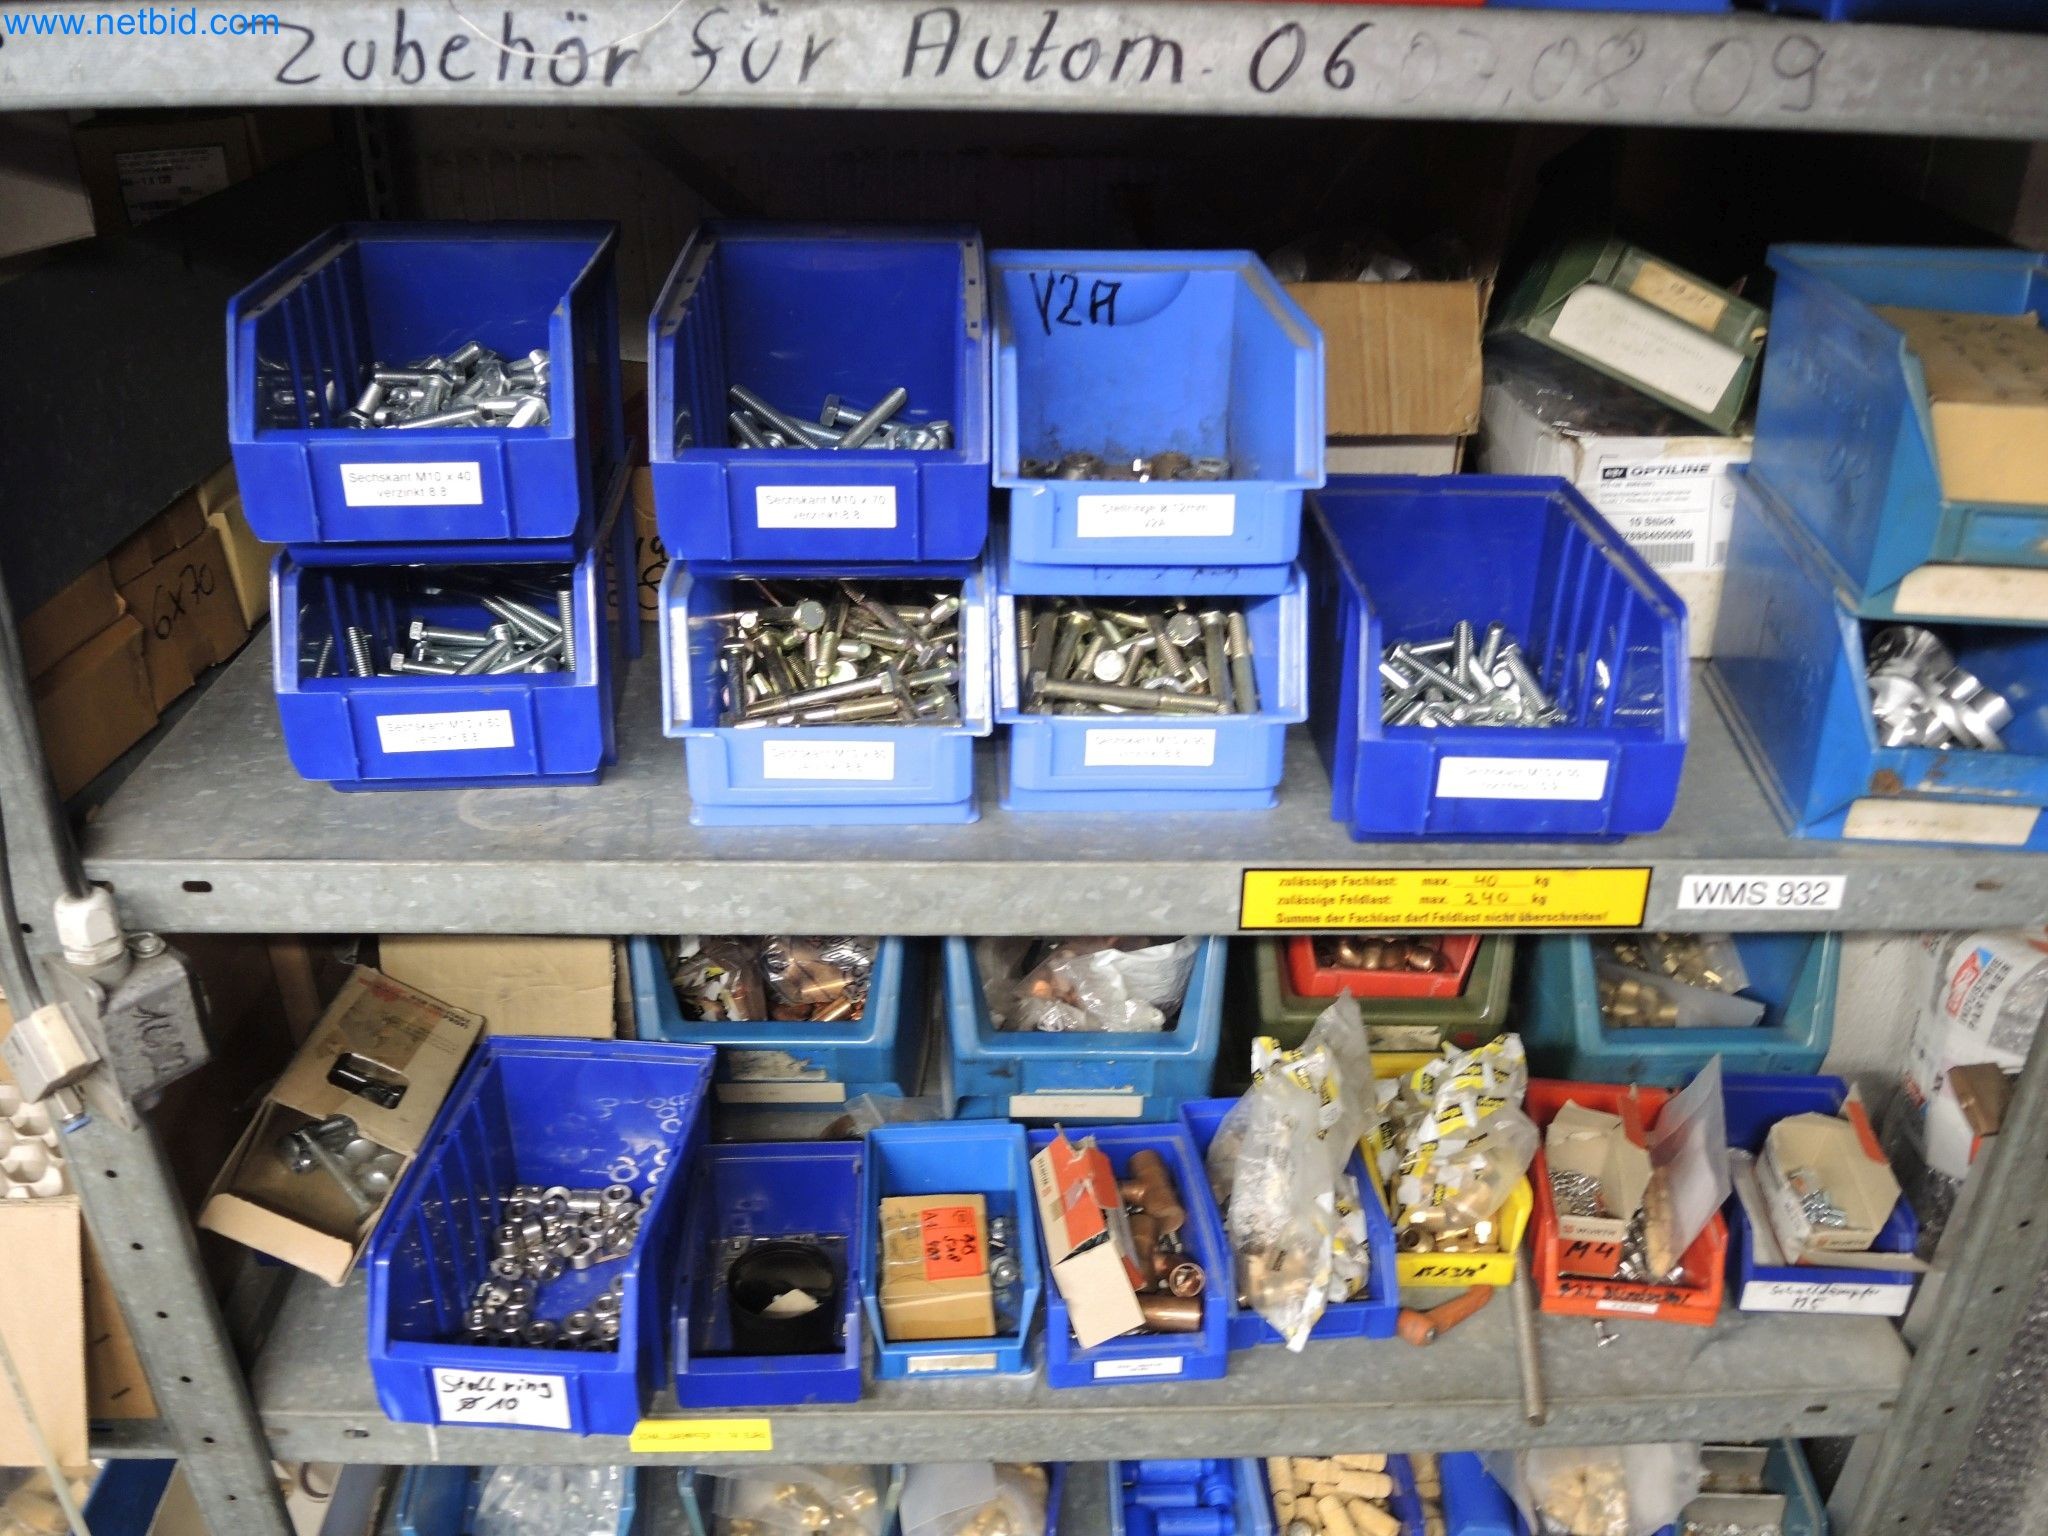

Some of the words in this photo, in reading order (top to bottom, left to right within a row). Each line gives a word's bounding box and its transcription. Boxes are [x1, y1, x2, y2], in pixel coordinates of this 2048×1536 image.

[239, 8, 639, 87] Zubehör
[678, 3, 837, 96] für
[1248, 21, 1375, 94] 06
[1029, 269, 1122, 336] V2A
[348, 471, 411, 483] Sechskant
[415, 470, 441, 482] M10
[1631, 463, 1712, 476] OPTILINE
[1279, 876, 1337, 889] zulässige
[1474, 874, 1498, 888] 40
[1534, 875, 1550, 889] kg
[1277, 894, 1336, 908] zulässige
[1464, 892, 1510, 906] 240
[1532, 893, 1548, 907] kg
[1693, 881, 1769, 906] WMS
[1776, 881, 1831, 905] 932
[1276, 912, 1321, 924] Summe
[1325, 912, 1345, 923] der
[1349, 912, 1402, 924] Fachlast
[1404, 911, 1429, 923] darf
[1431, 911, 1481, 923] Feldlast
[1483, 911, 1516, 923] nicht
